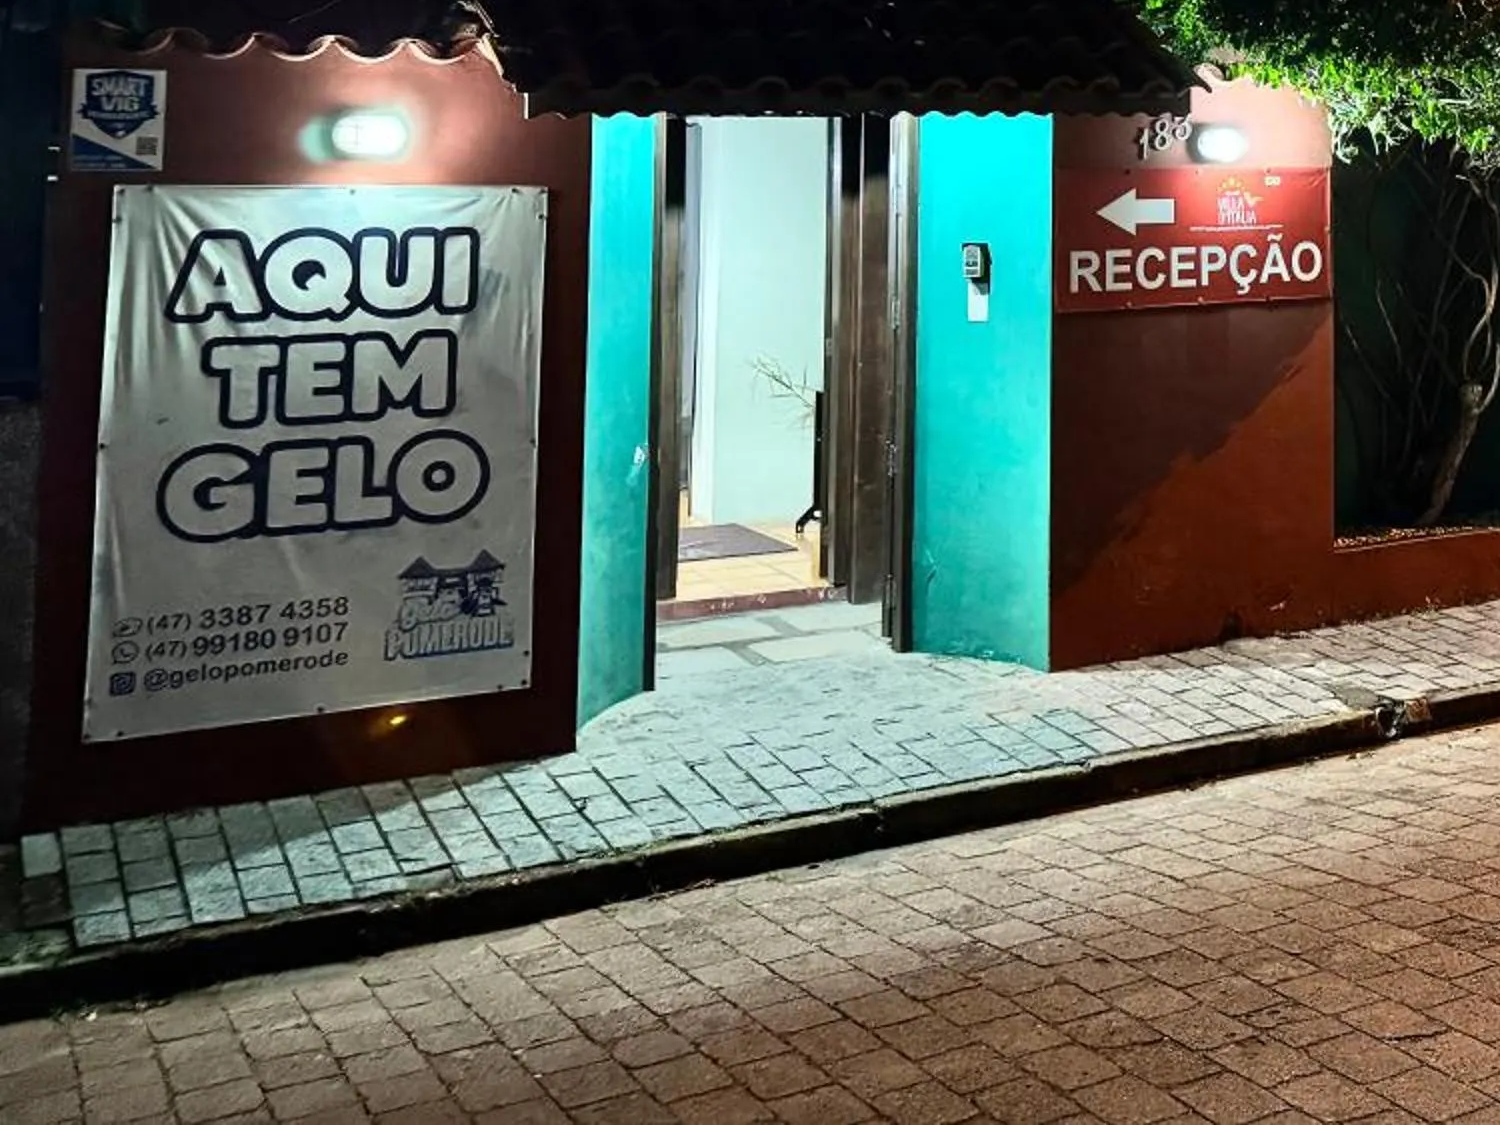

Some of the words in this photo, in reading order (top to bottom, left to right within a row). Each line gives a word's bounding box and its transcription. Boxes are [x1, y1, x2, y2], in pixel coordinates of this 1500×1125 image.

[91, 76, 150, 97] SMART
[99, 96, 141, 112] VIG
[164, 227, 480, 323] AQUI
[1069, 233, 1323, 294] RECEPÇÃO
[202, 329, 458, 430] TEM
[156, 429, 490, 543] GELO
[147, 613, 192, 635] (47)
[200, 604, 271, 629] 3387
[279, 596, 349, 620] 4358
[145, 640, 187, 663] (47)
[192, 628, 276, 657] 99180
[283, 622, 349, 647] 9107
[143, 650, 349, 692] @gelopomerode
